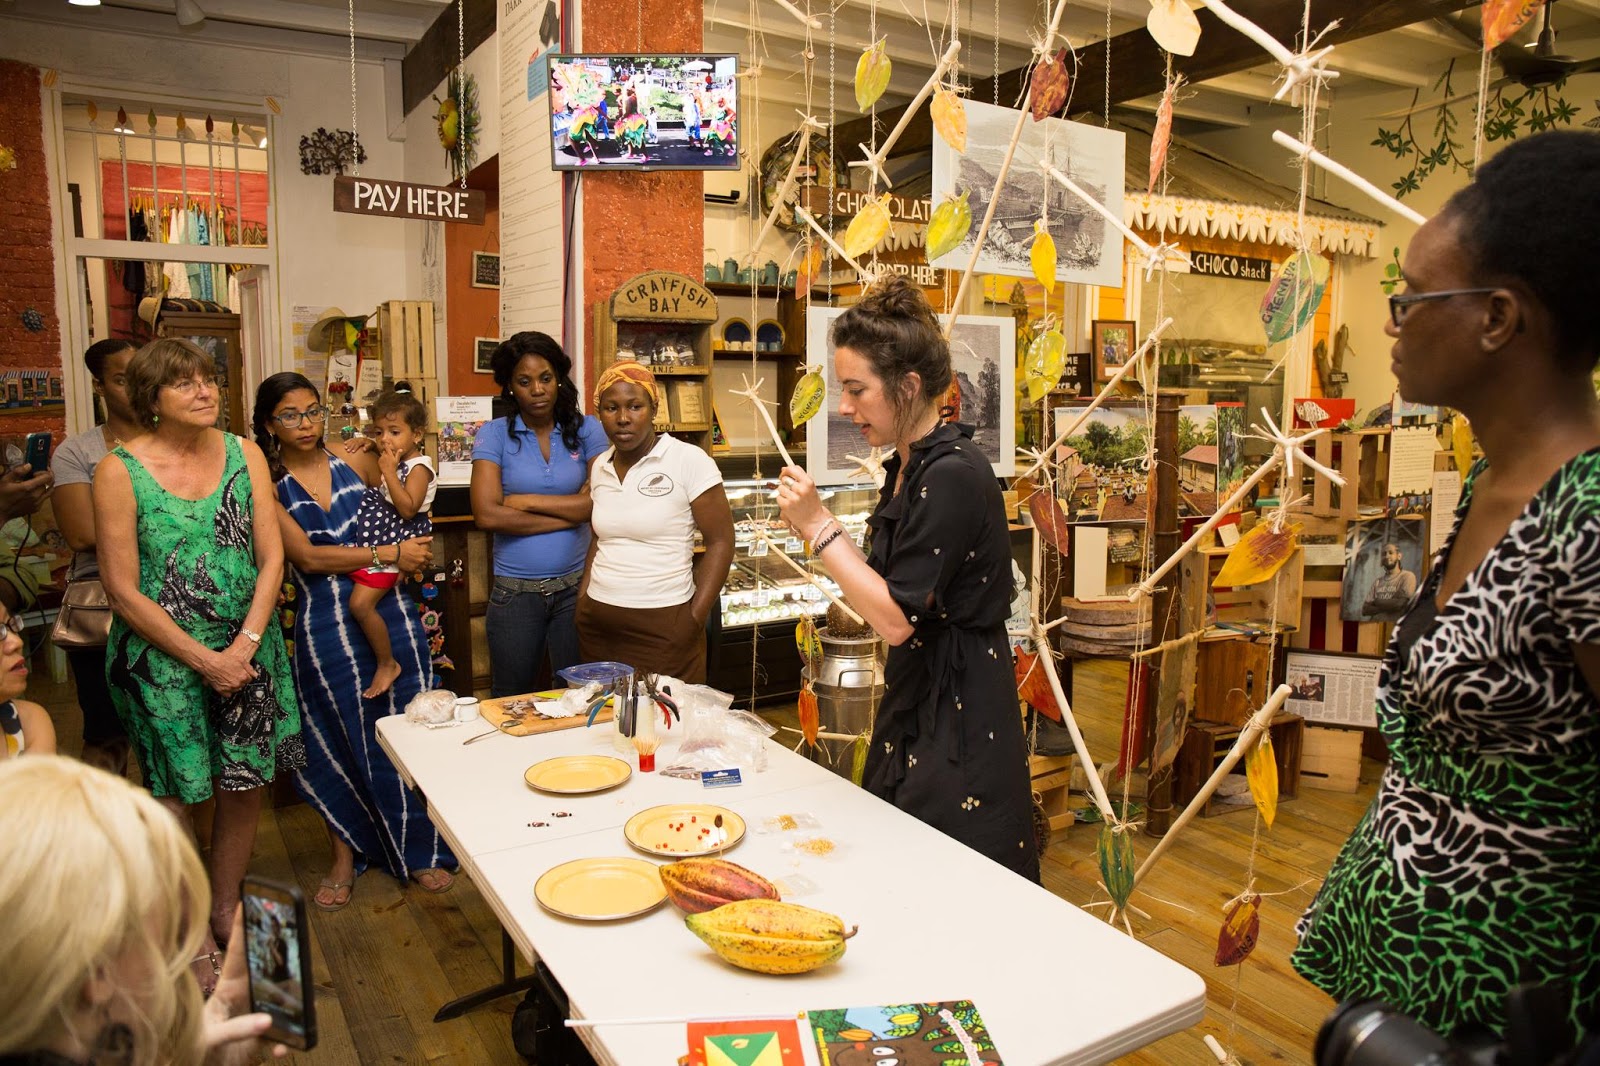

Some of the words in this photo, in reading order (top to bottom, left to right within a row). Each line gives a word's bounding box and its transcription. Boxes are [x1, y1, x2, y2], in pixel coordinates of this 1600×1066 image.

[354, 181, 401, 212] PAY
[407, 187, 470, 219] HERE
[911, 265, 939, 286] HERE
[1196, 254, 1238, 276] CHOCO
[626, 277, 709, 309] CRAYFISH
[649, 297, 680, 313] BAY
